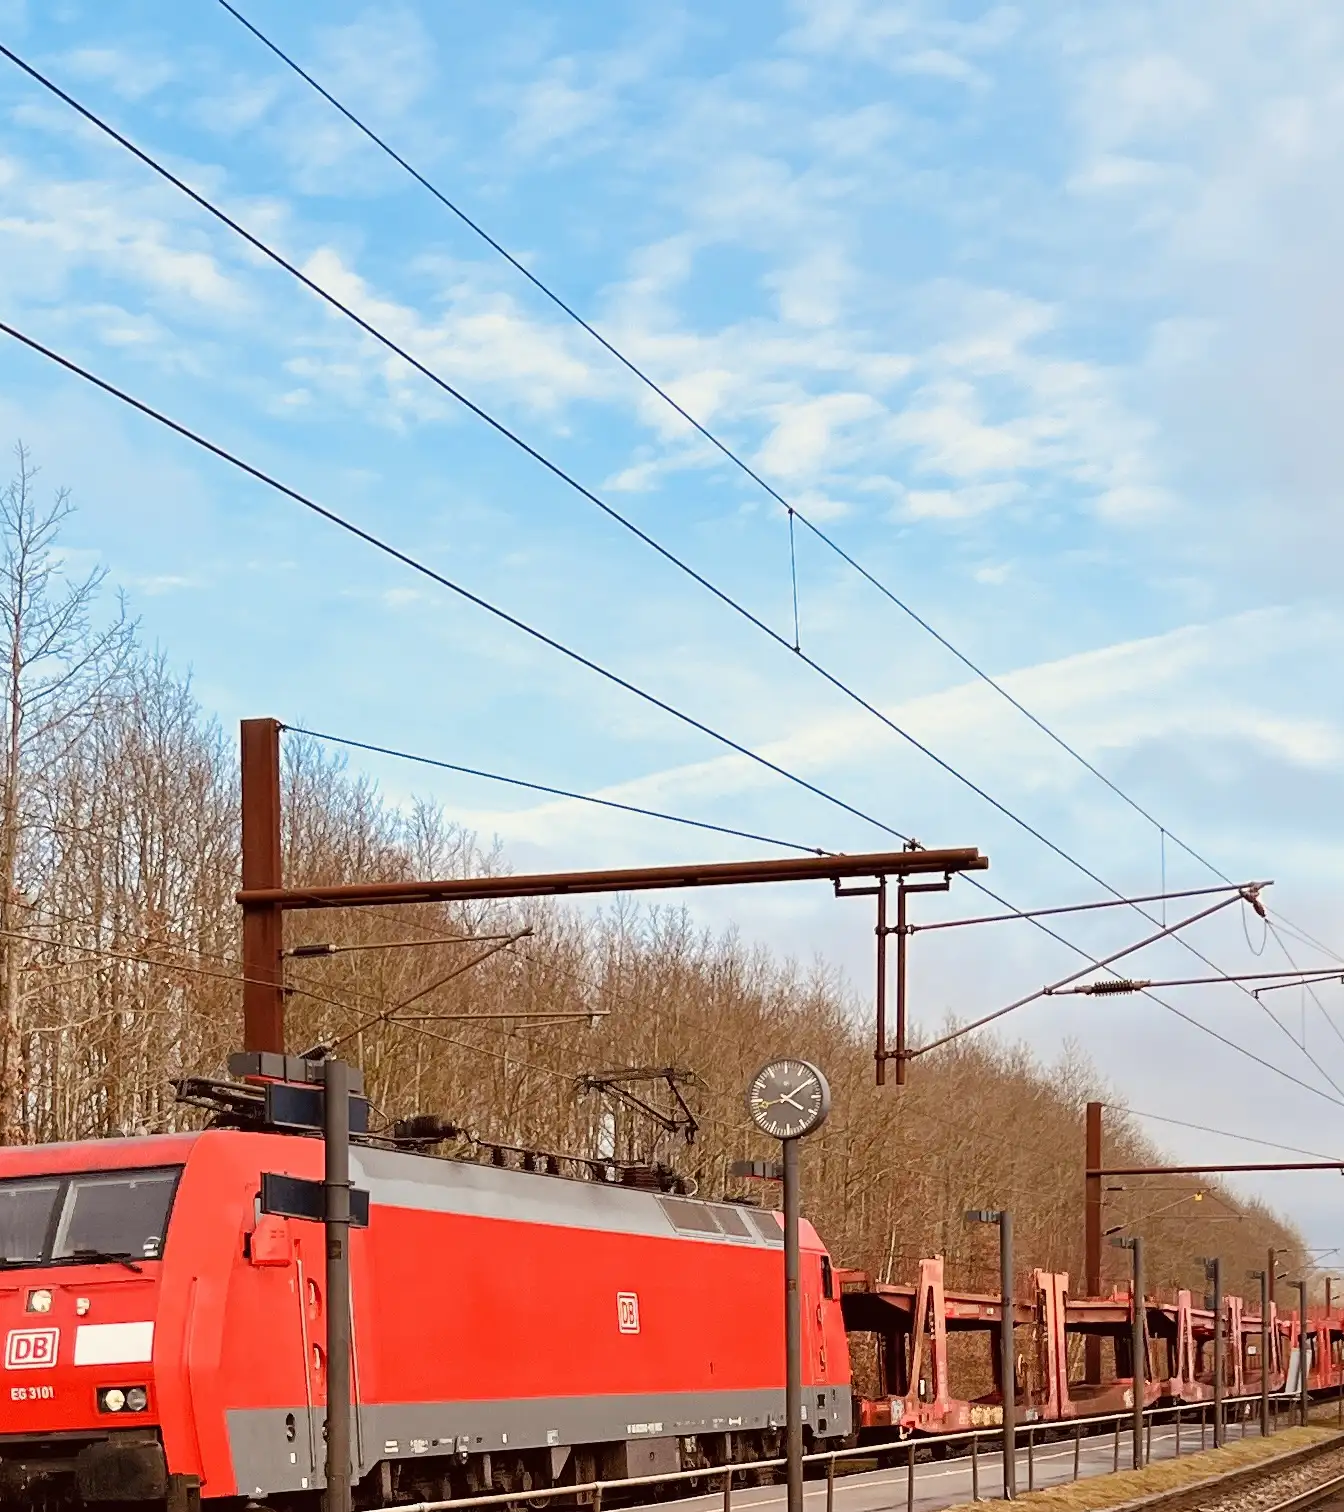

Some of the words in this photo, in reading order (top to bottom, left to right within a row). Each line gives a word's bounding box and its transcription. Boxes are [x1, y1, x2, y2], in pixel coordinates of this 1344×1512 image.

[16, 1337, 48, 1359] DB
[10, 1387, 27, 1400] EG
[29, 1385, 54, 1399] 3101
